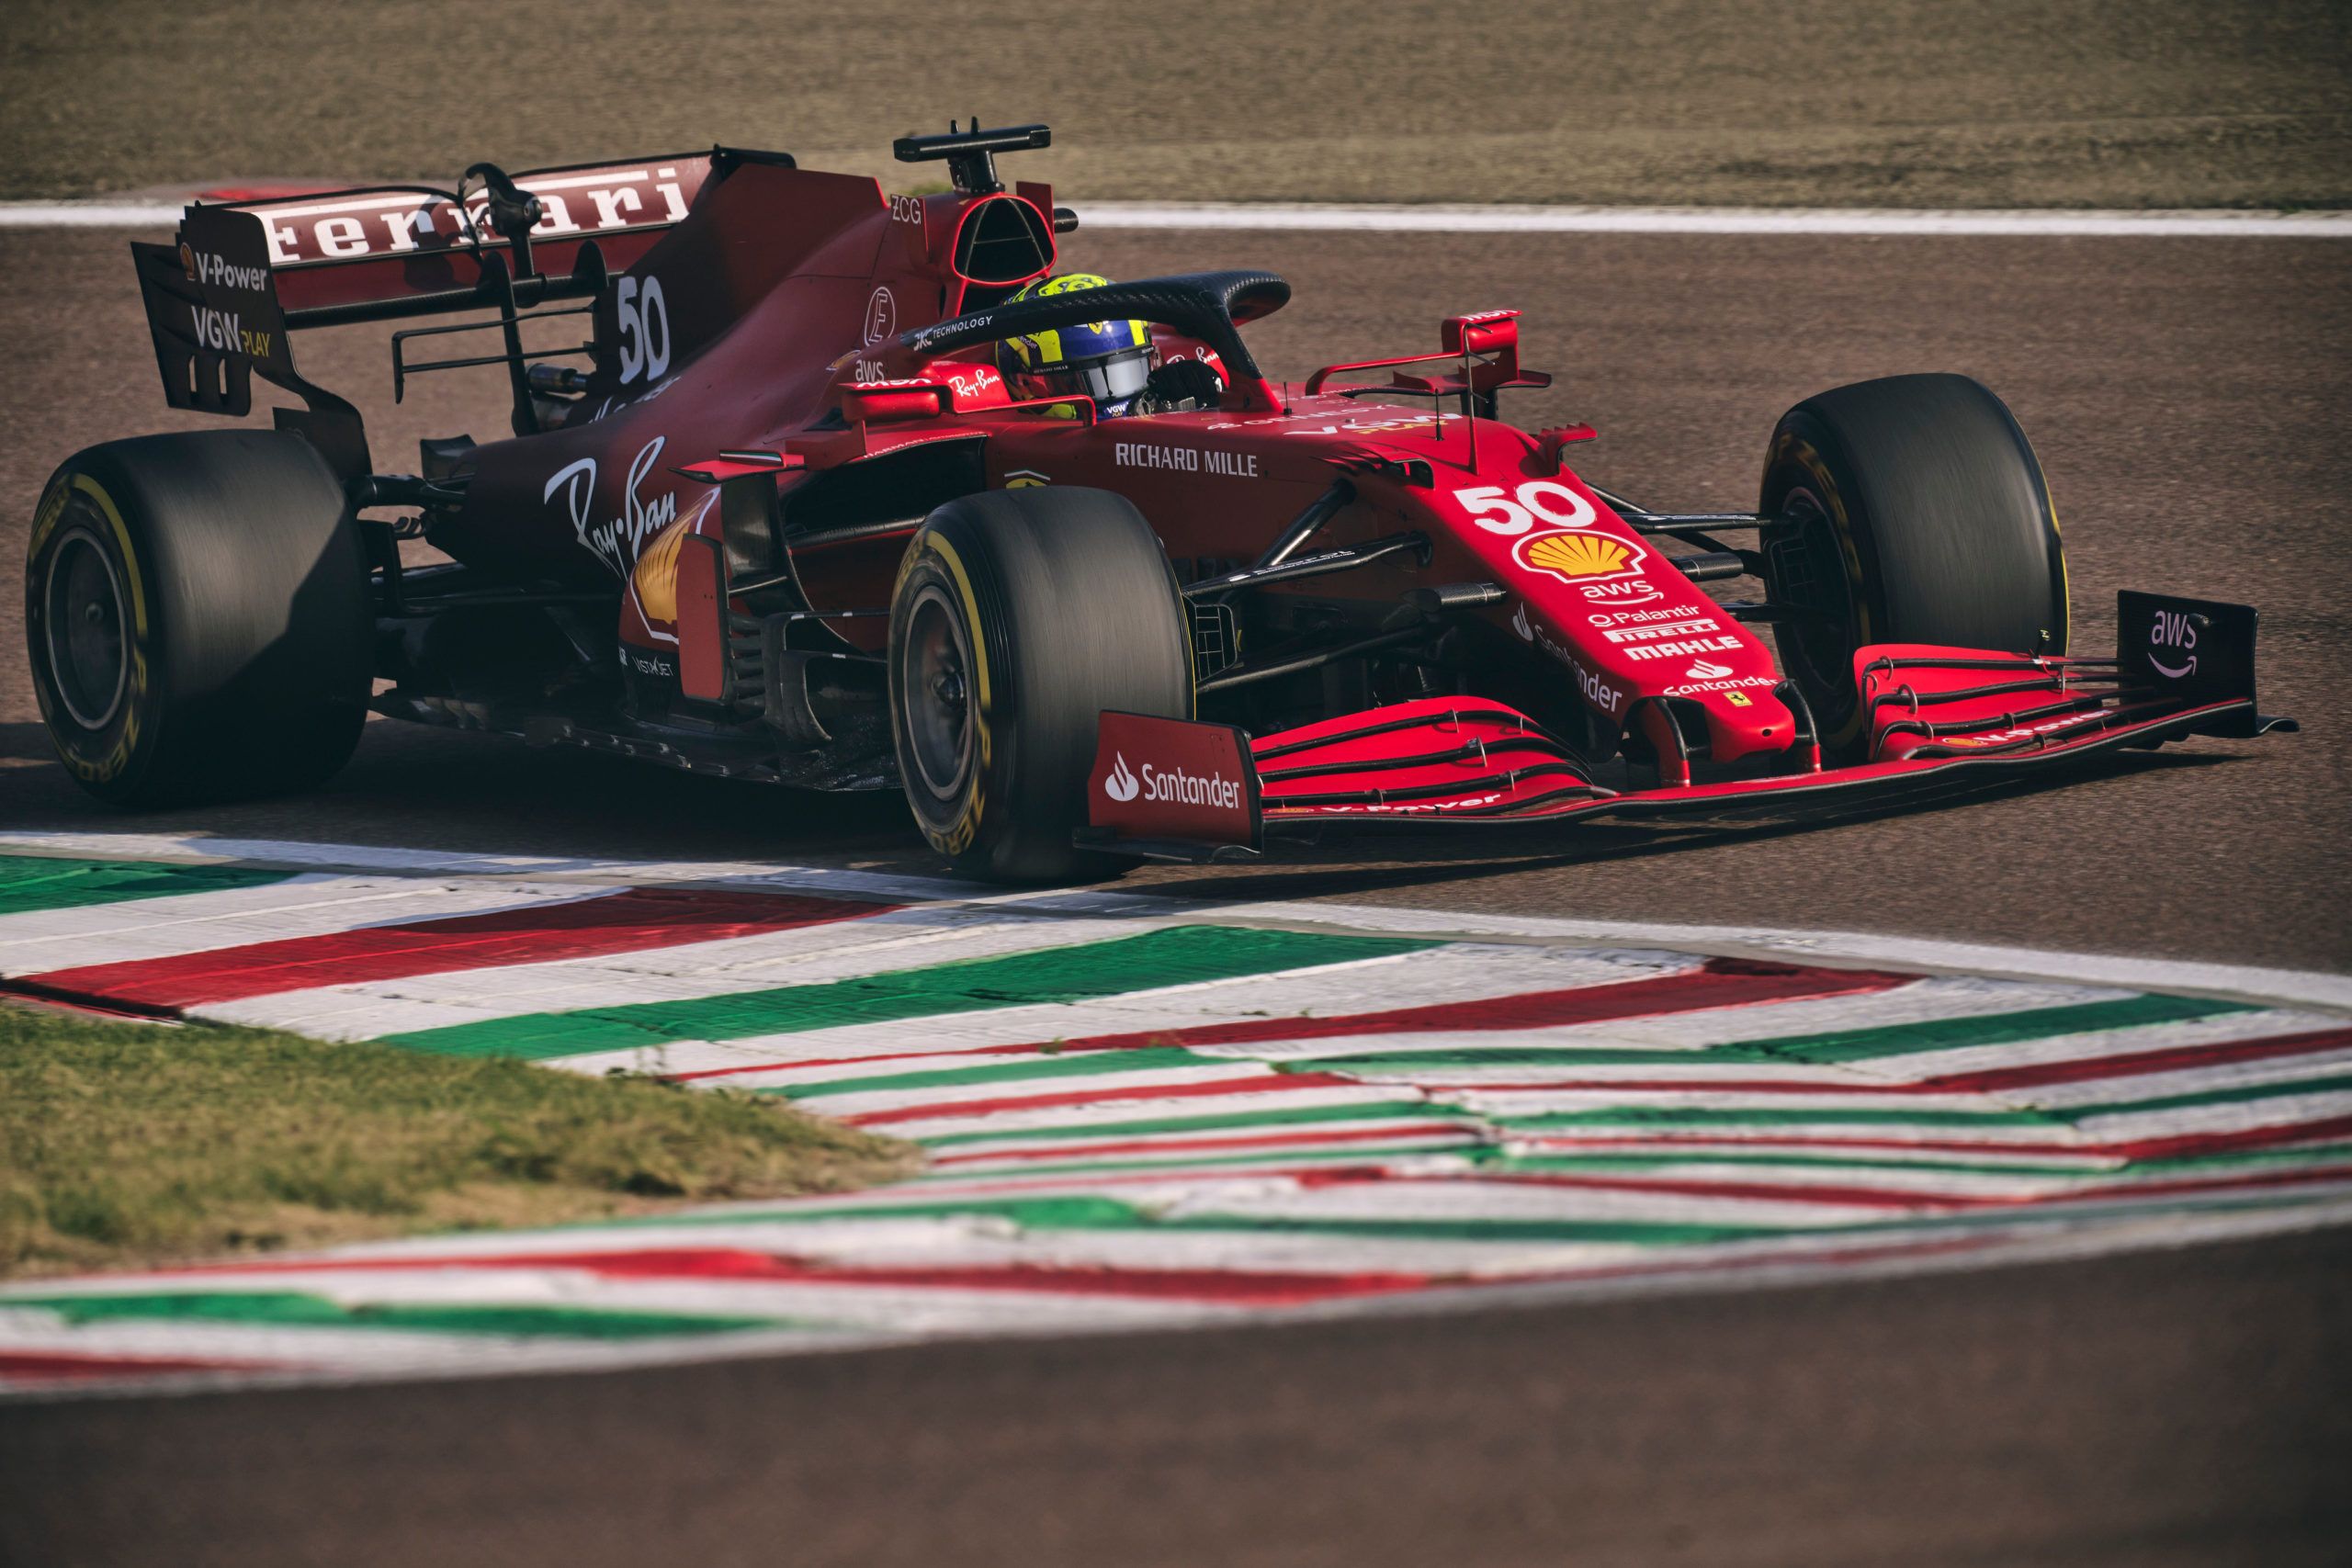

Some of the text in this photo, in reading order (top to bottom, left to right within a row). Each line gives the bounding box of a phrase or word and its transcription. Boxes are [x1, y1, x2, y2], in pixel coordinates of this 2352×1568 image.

[260, 167, 690, 265] Ferrari
[196, 252, 267, 291] V-Power
[191, 305, 243, 353] VGW
[617, 275, 671, 385] 50
[933, 315, 993, 339] TECHNOLOGY
[241, 330, 271, 358] PLAY
[855, 359, 885, 383] aws
[1106, 402, 1127, 414] VGW
[1115, 442, 1259, 479] RICHARD MILLE
[1452, 480, 1598, 536] 50
[1579, 580, 1656, 599] aws
[1614, 604, 1702, 626] Palantir
[1601, 618, 1722, 643] PIRELLI
[2151, 610, 2197, 649] aws
[1623, 635, 1745, 660] MAHLE
[1662, 675, 1780, 698] Santander
[1141, 762, 1239, 809] Santander
[1320, 794, 1501, 813] V-Power
